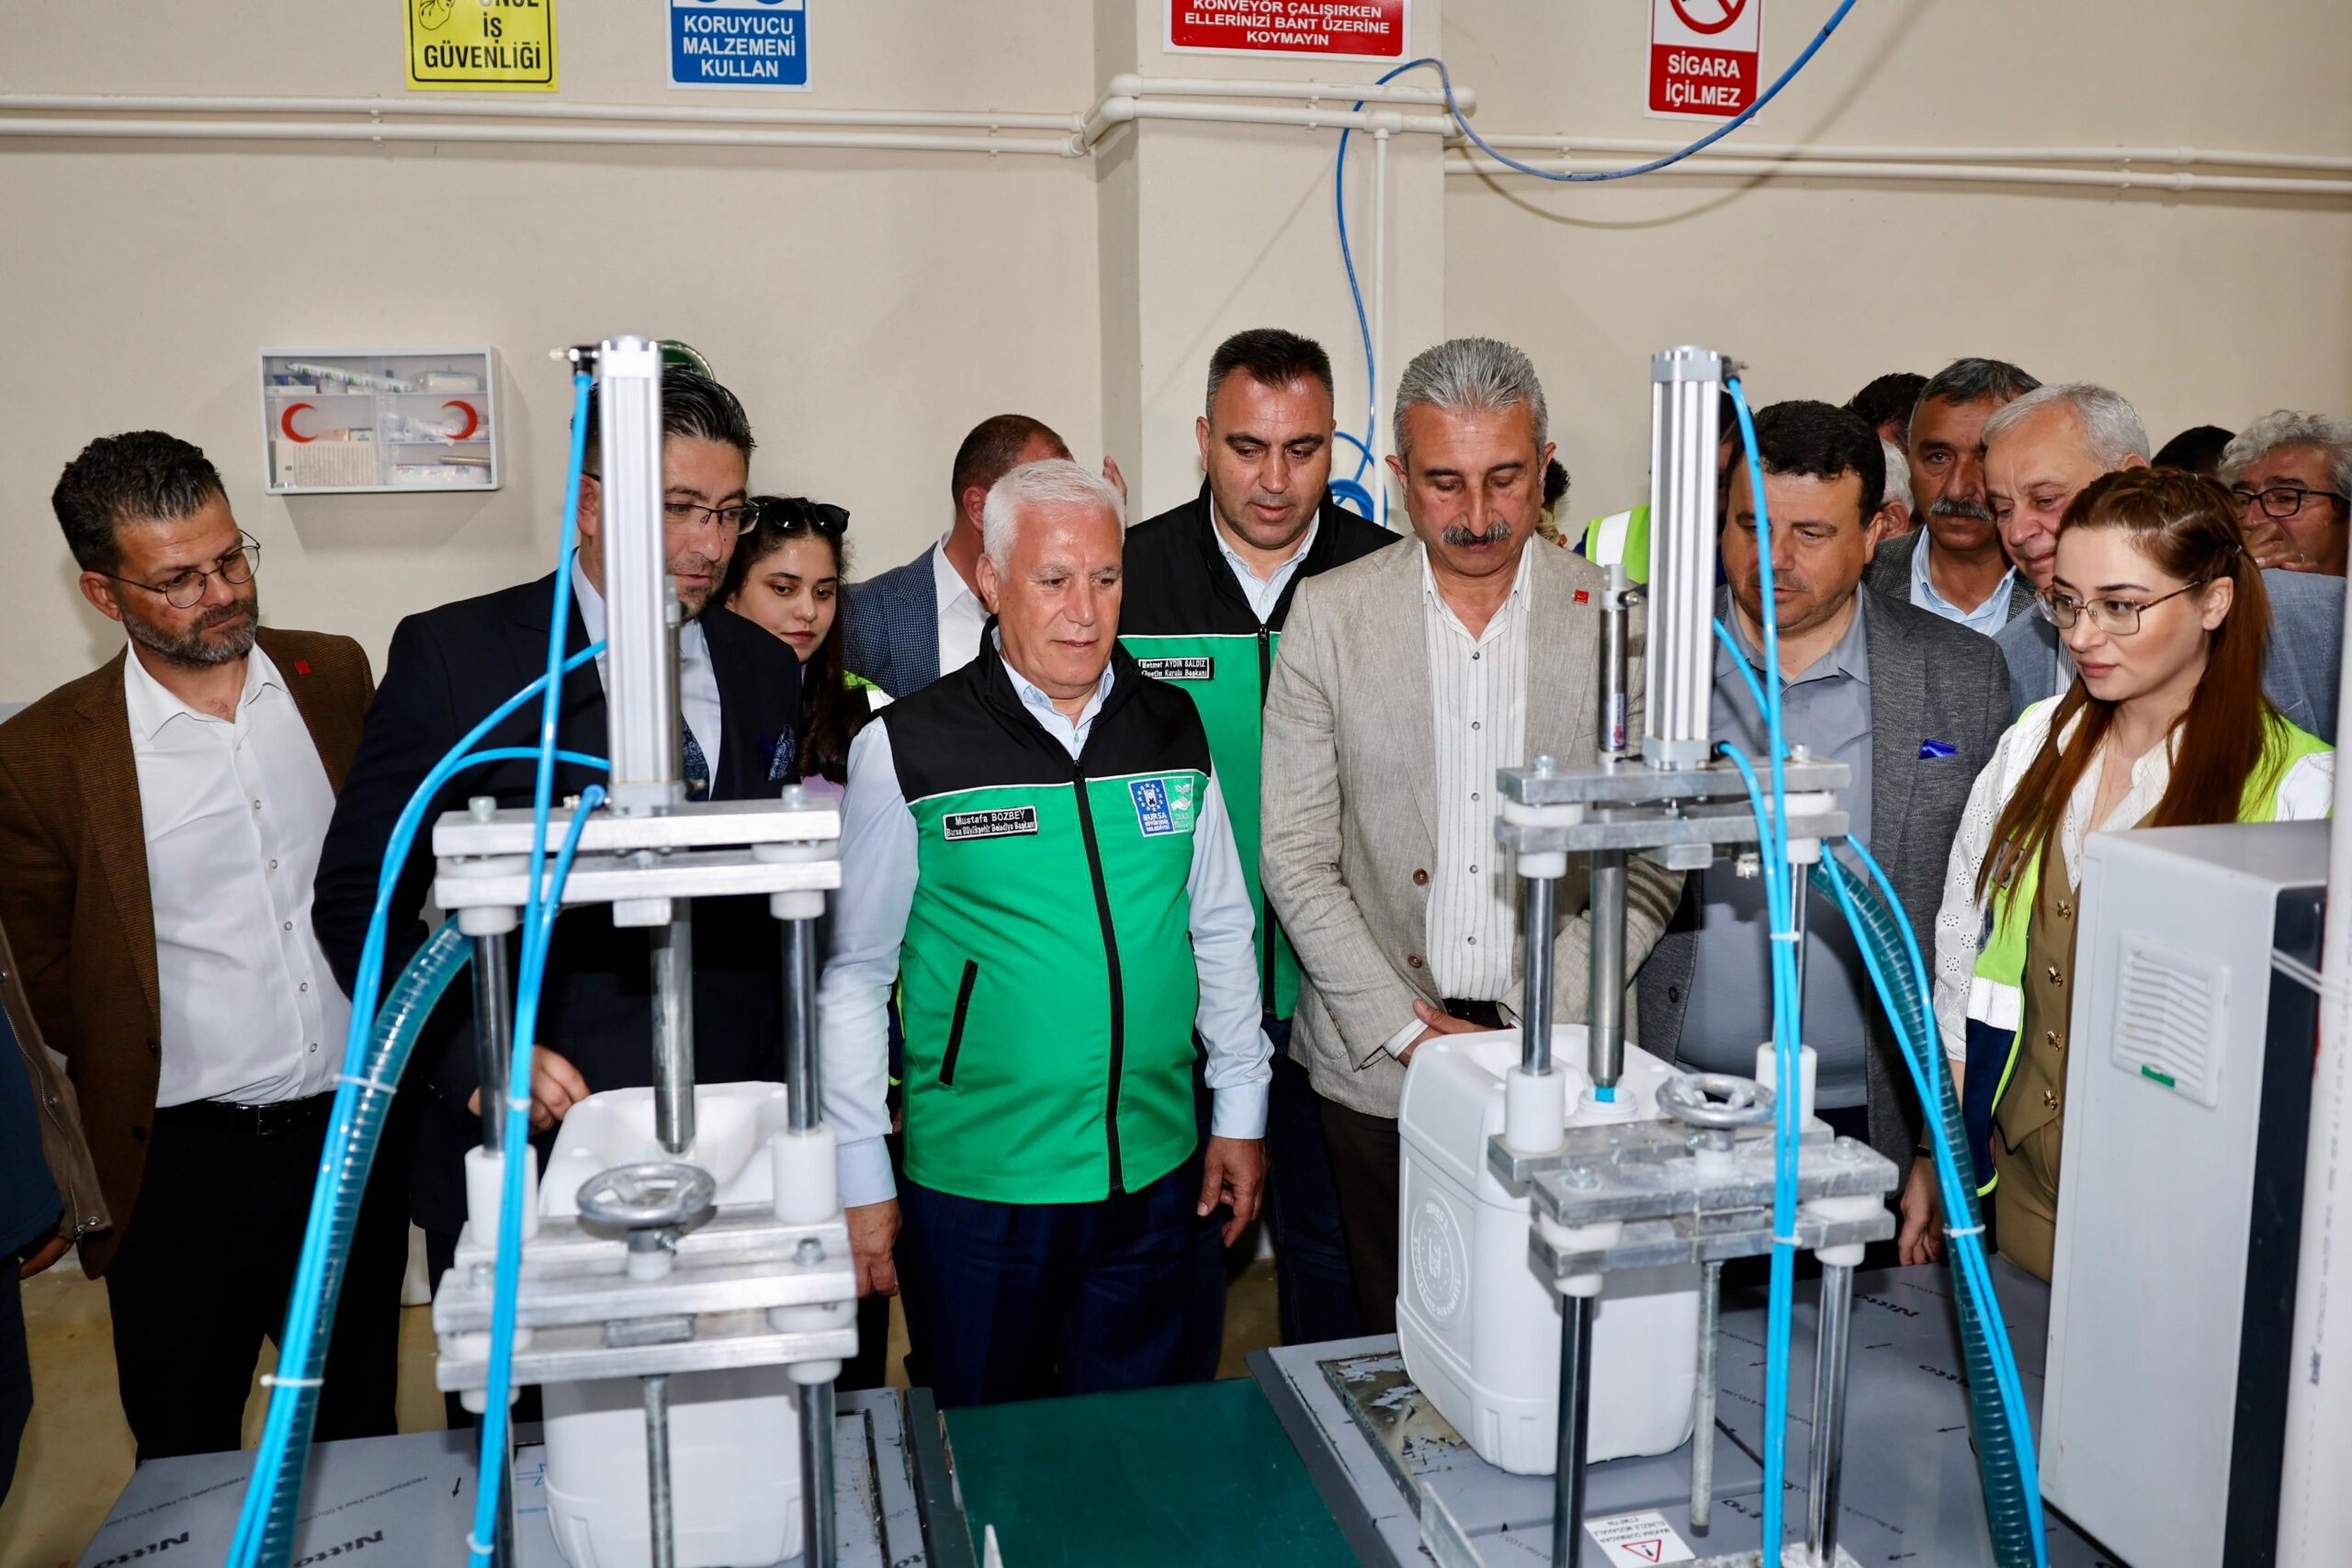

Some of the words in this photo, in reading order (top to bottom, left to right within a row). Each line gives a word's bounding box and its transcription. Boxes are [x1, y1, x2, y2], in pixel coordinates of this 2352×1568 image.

[1193, 0, 1283, 13] KONVEYÖR
[1287, 2, 1382, 18] ÇALIŞIRKEN
[483, 12, 503, 43] İŞ
[684, 15, 793, 35] KORUYUCU
[1184, 12, 1271, 28] ELLERİNİZİ
[1274, 17, 1318, 30] BANT
[1322, 16, 1390, 34] ÜZERİNE
[683, 35, 796, 56] MALZEMENİ
[1247, 30, 1329, 46] KOYMAYIN
[424, 39, 541, 70] GÜVENLİĞİ
[1668, 50, 1741, 79] SİGARA
[701, 59, 779, 77] KULLAN
[1665, 77, 1741, 107] İÇİLMEZ
[955, 814, 988, 826] Mustafa
[991, 810, 1025, 822] BOZBEY
[1142, 812, 1168, 822] BURSA
[1852, 1292, 1920, 1317] Nitto
[93, 1531, 189, 1568] Nitto
[294, 1530, 384, 1567] Nitto
